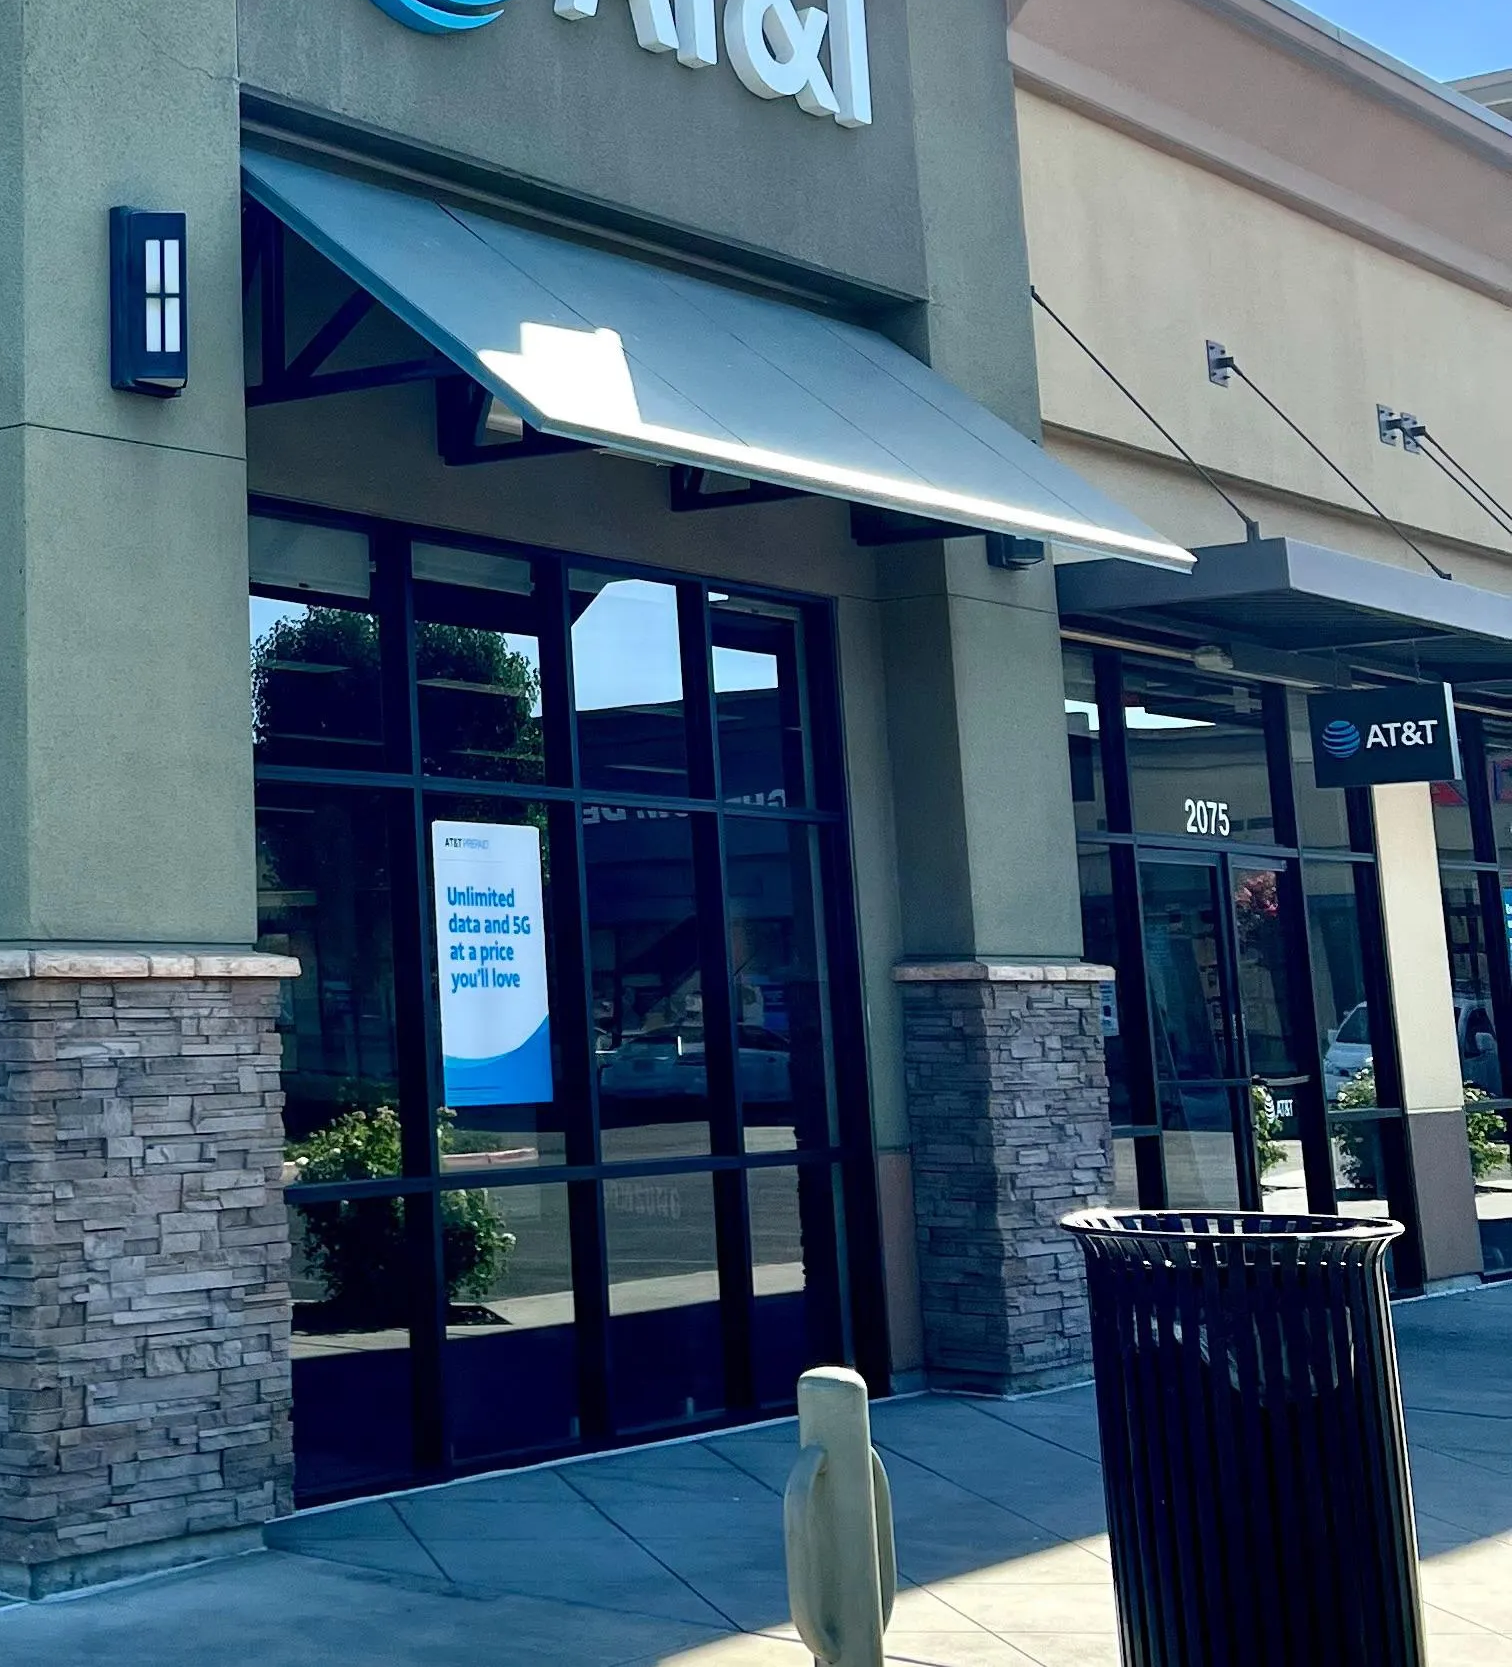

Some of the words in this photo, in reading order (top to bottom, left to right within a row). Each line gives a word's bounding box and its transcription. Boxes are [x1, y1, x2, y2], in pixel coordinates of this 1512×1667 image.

[1366, 719, 1438, 750] AT&T
[1185, 799, 1230, 836] 2075
[445, 837, 462, 848] AT&T
[447, 886, 515, 908] Unlimited
[449, 913, 481, 933] data
[484, 914, 510, 934] and
[513, 915, 531, 935] 5G
[450, 942, 465, 961] at
[468, 945, 476, 961] a
[480, 940, 514, 966] price
[451, 968, 488, 994] you'll
[492, 968, 521, 988] love
